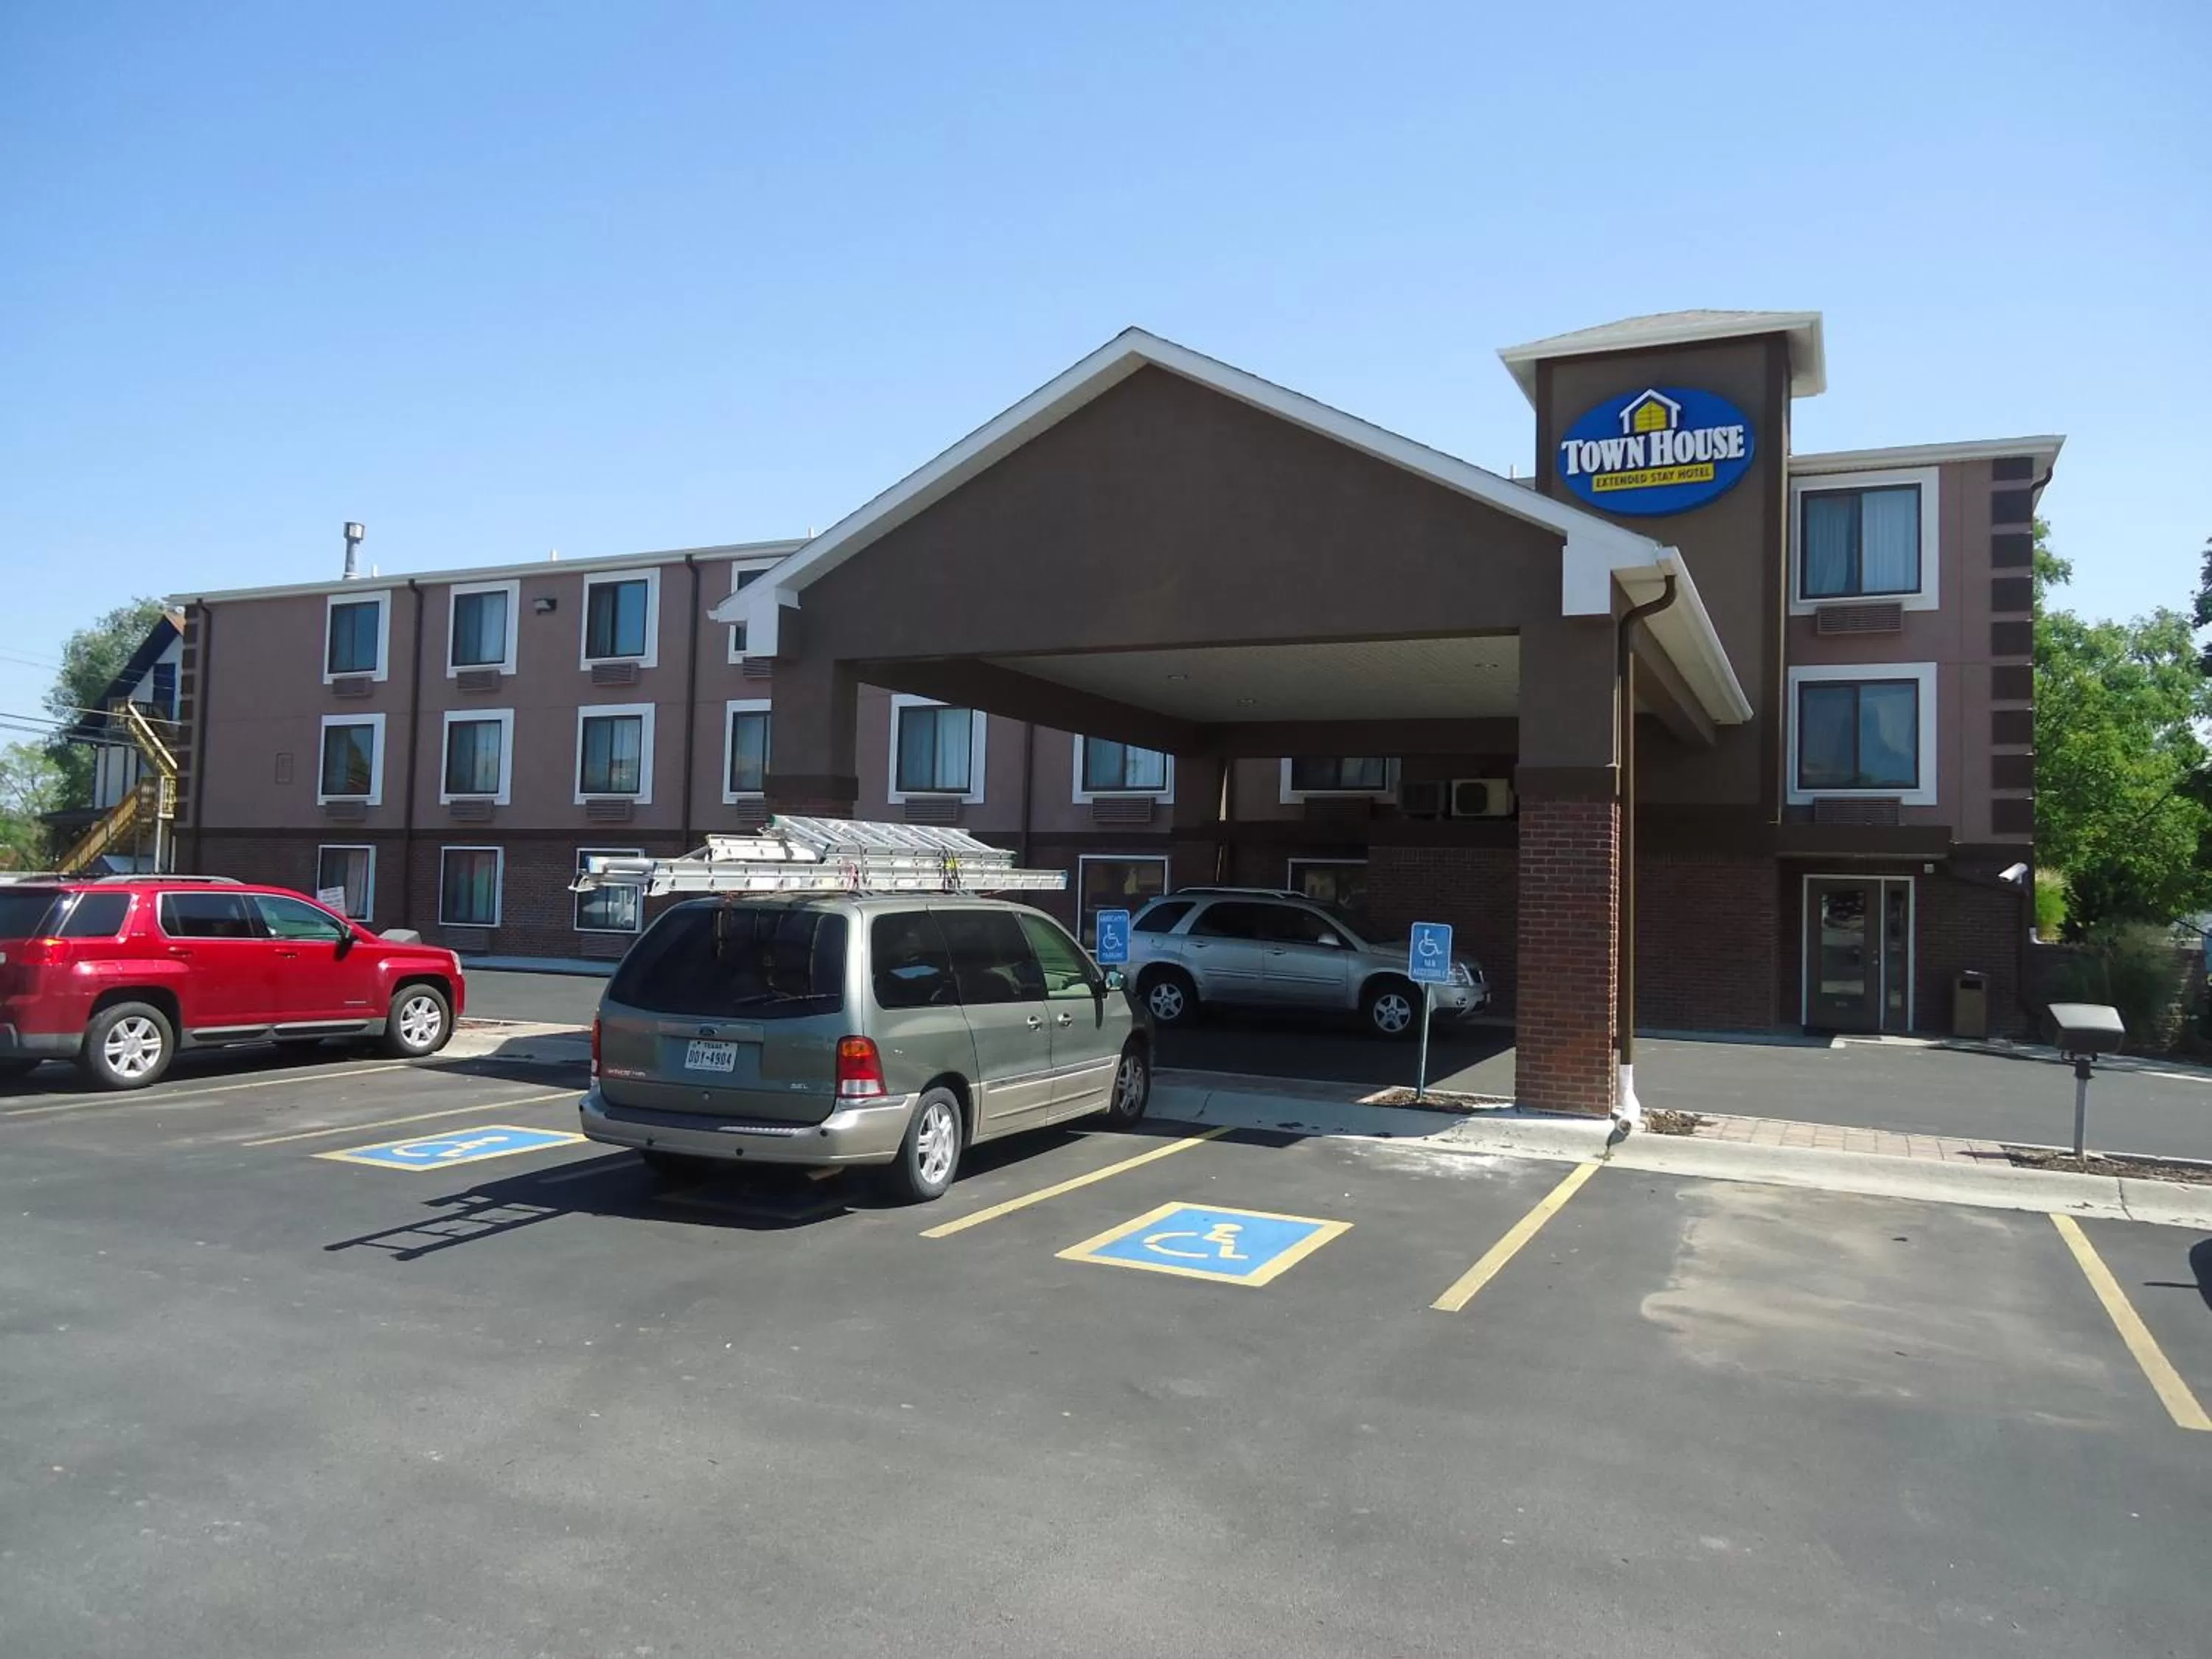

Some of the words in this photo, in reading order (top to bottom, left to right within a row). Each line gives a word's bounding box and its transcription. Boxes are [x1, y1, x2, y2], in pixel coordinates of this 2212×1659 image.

[1561, 435, 1646, 476] TOWN
[1649, 425, 1745, 466] HOUSE
[1596, 473, 1647, 488] EXTENDED
[1650, 470, 1675, 483] STAY
[1677, 466, 1711, 480] HOTEL
